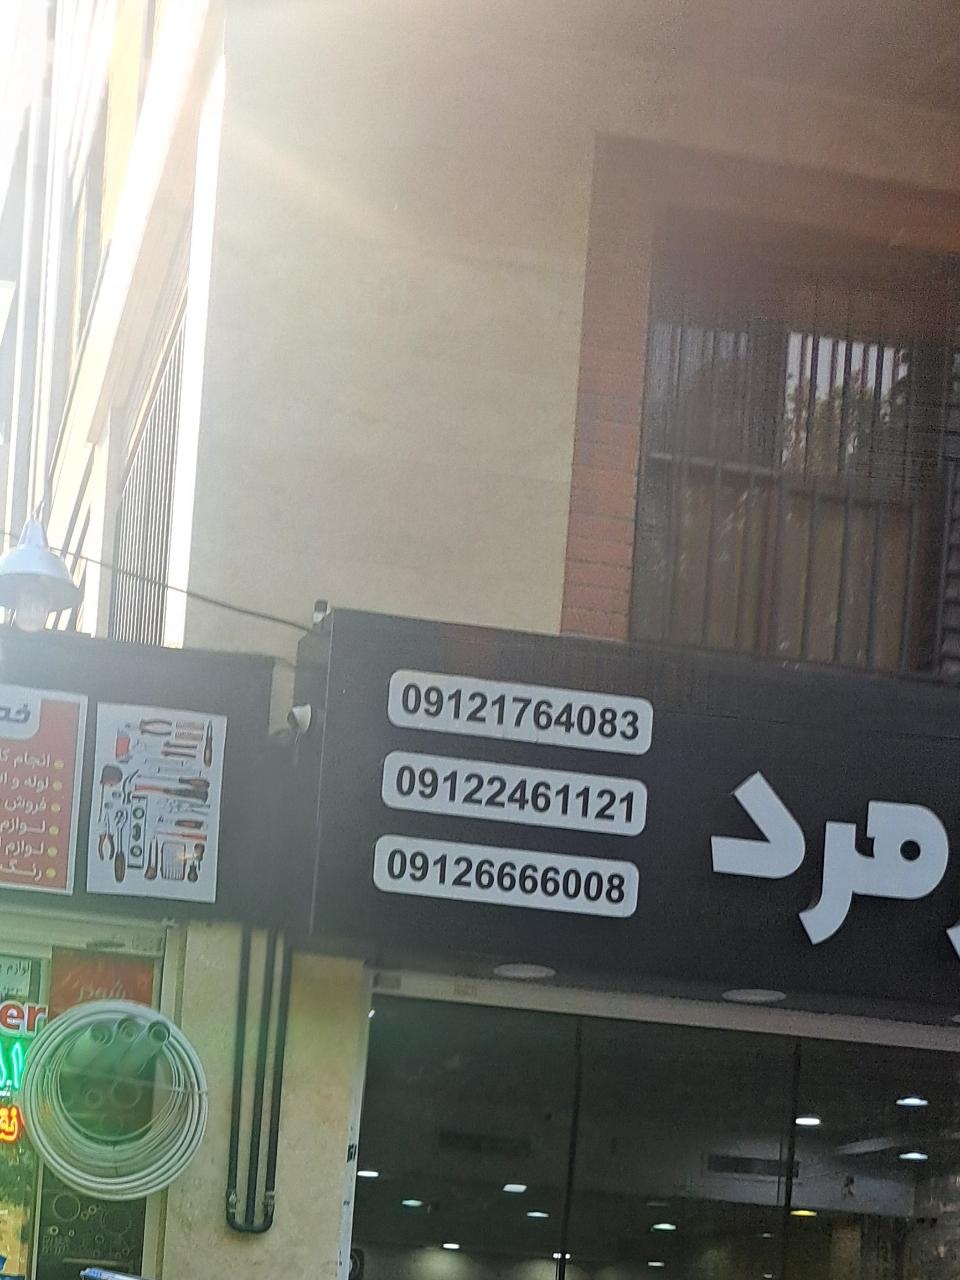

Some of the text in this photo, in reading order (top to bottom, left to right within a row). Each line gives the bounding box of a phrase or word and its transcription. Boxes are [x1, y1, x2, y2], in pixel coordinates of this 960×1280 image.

[401, 682, 641, 742] 09121764083
[395, 763, 637, 825] 09122461121
[386, 847, 627, 906] 09126666008
[710, 770, 960, 961] مرد
